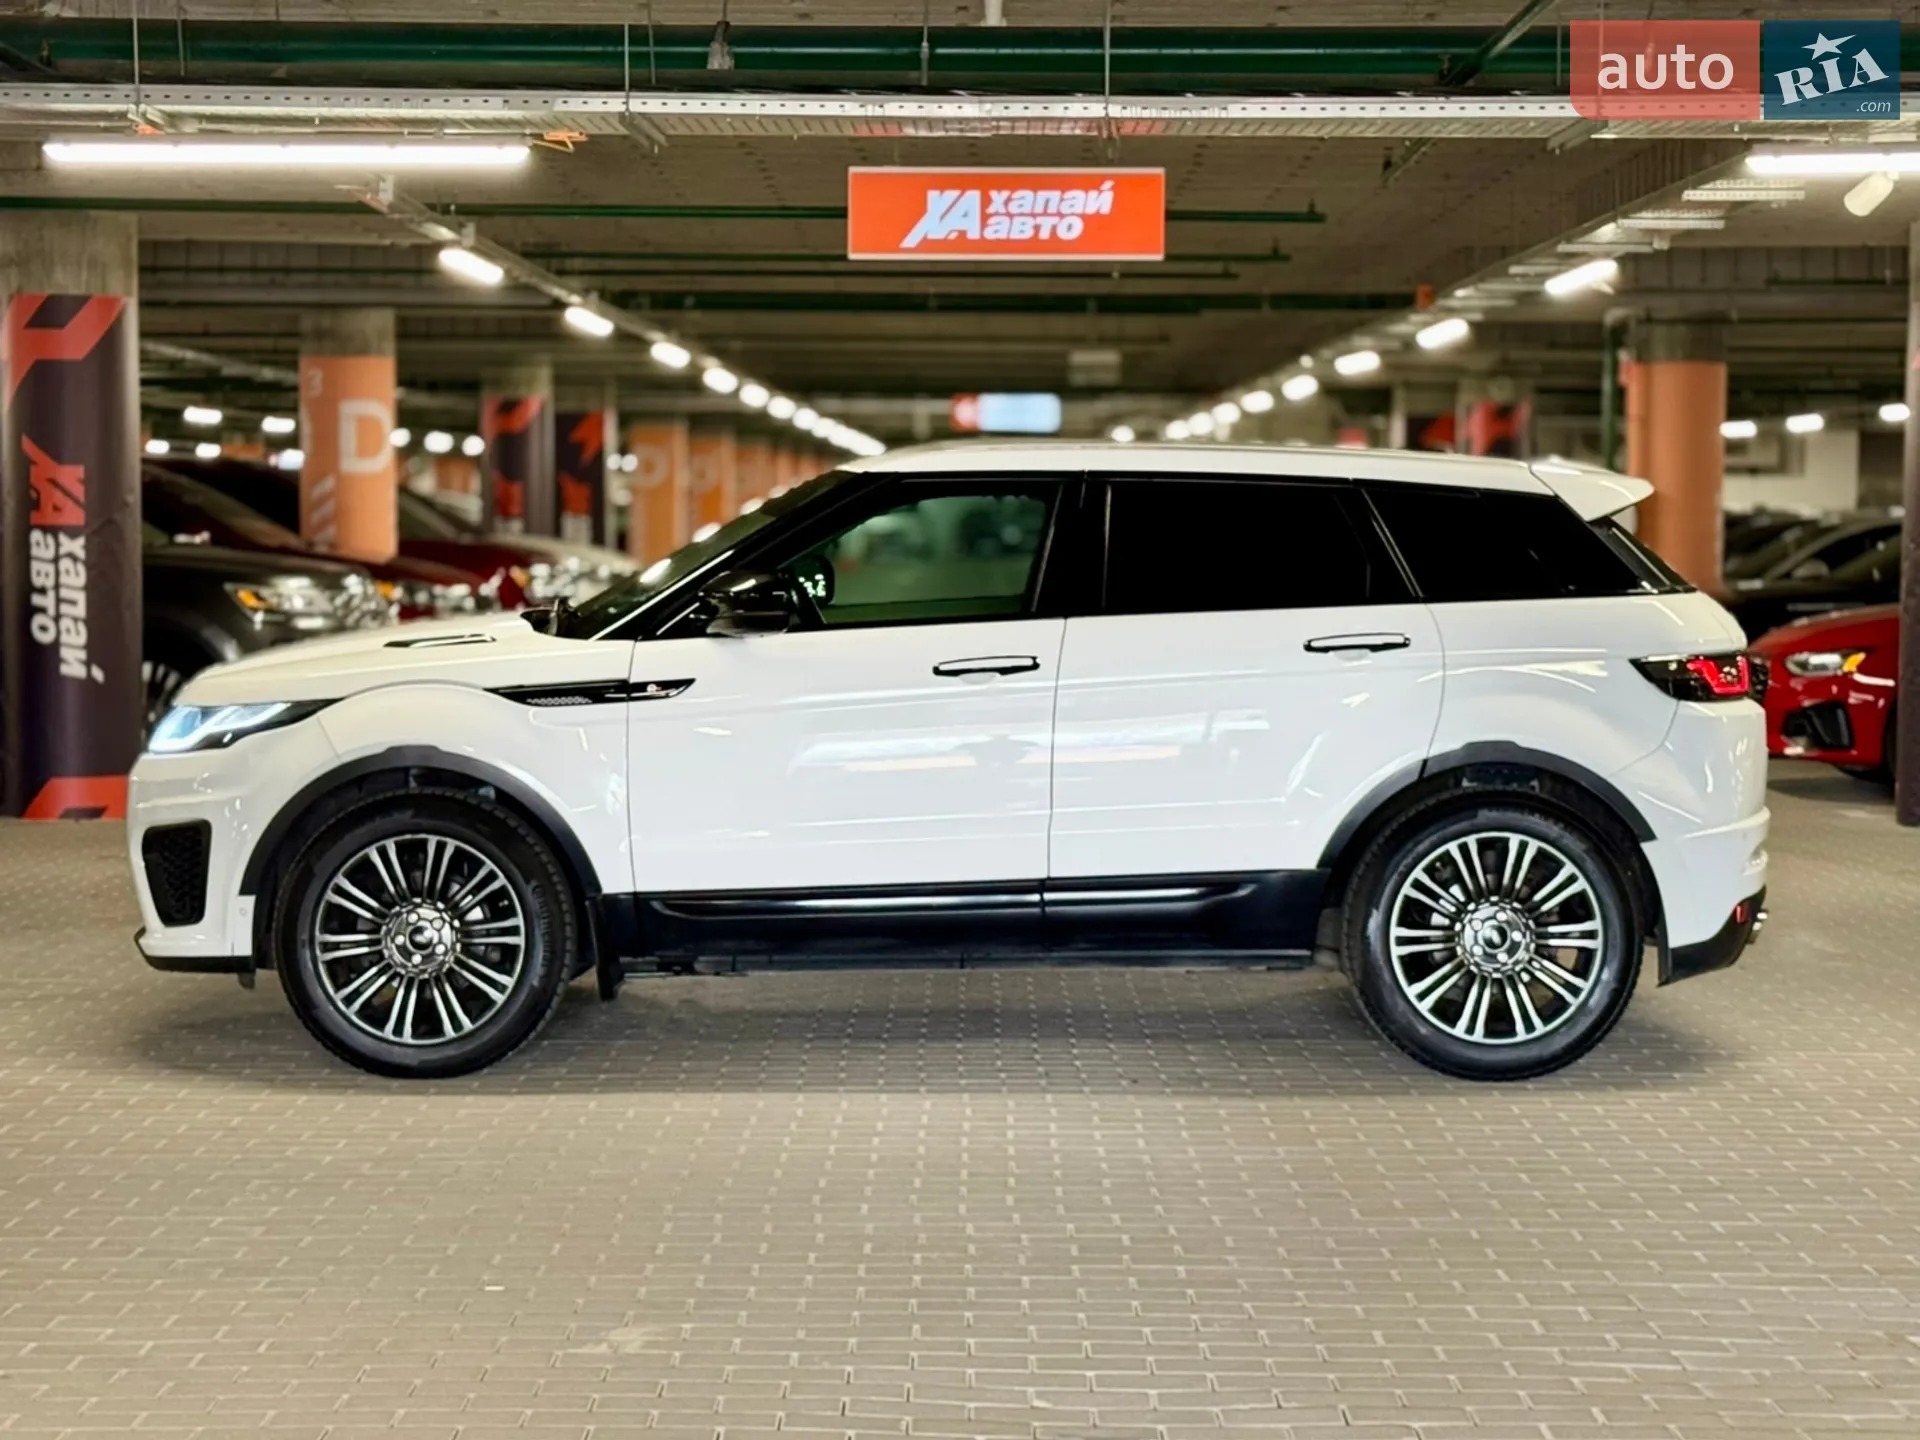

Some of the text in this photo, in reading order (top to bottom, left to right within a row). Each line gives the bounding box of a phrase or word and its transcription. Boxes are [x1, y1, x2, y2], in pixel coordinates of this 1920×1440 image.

[983, 215, 1084, 240] авто
[986, 180, 1115, 214] хапай
[29, 527, 57, 645] авто
[58, 531, 105, 685] хапай
